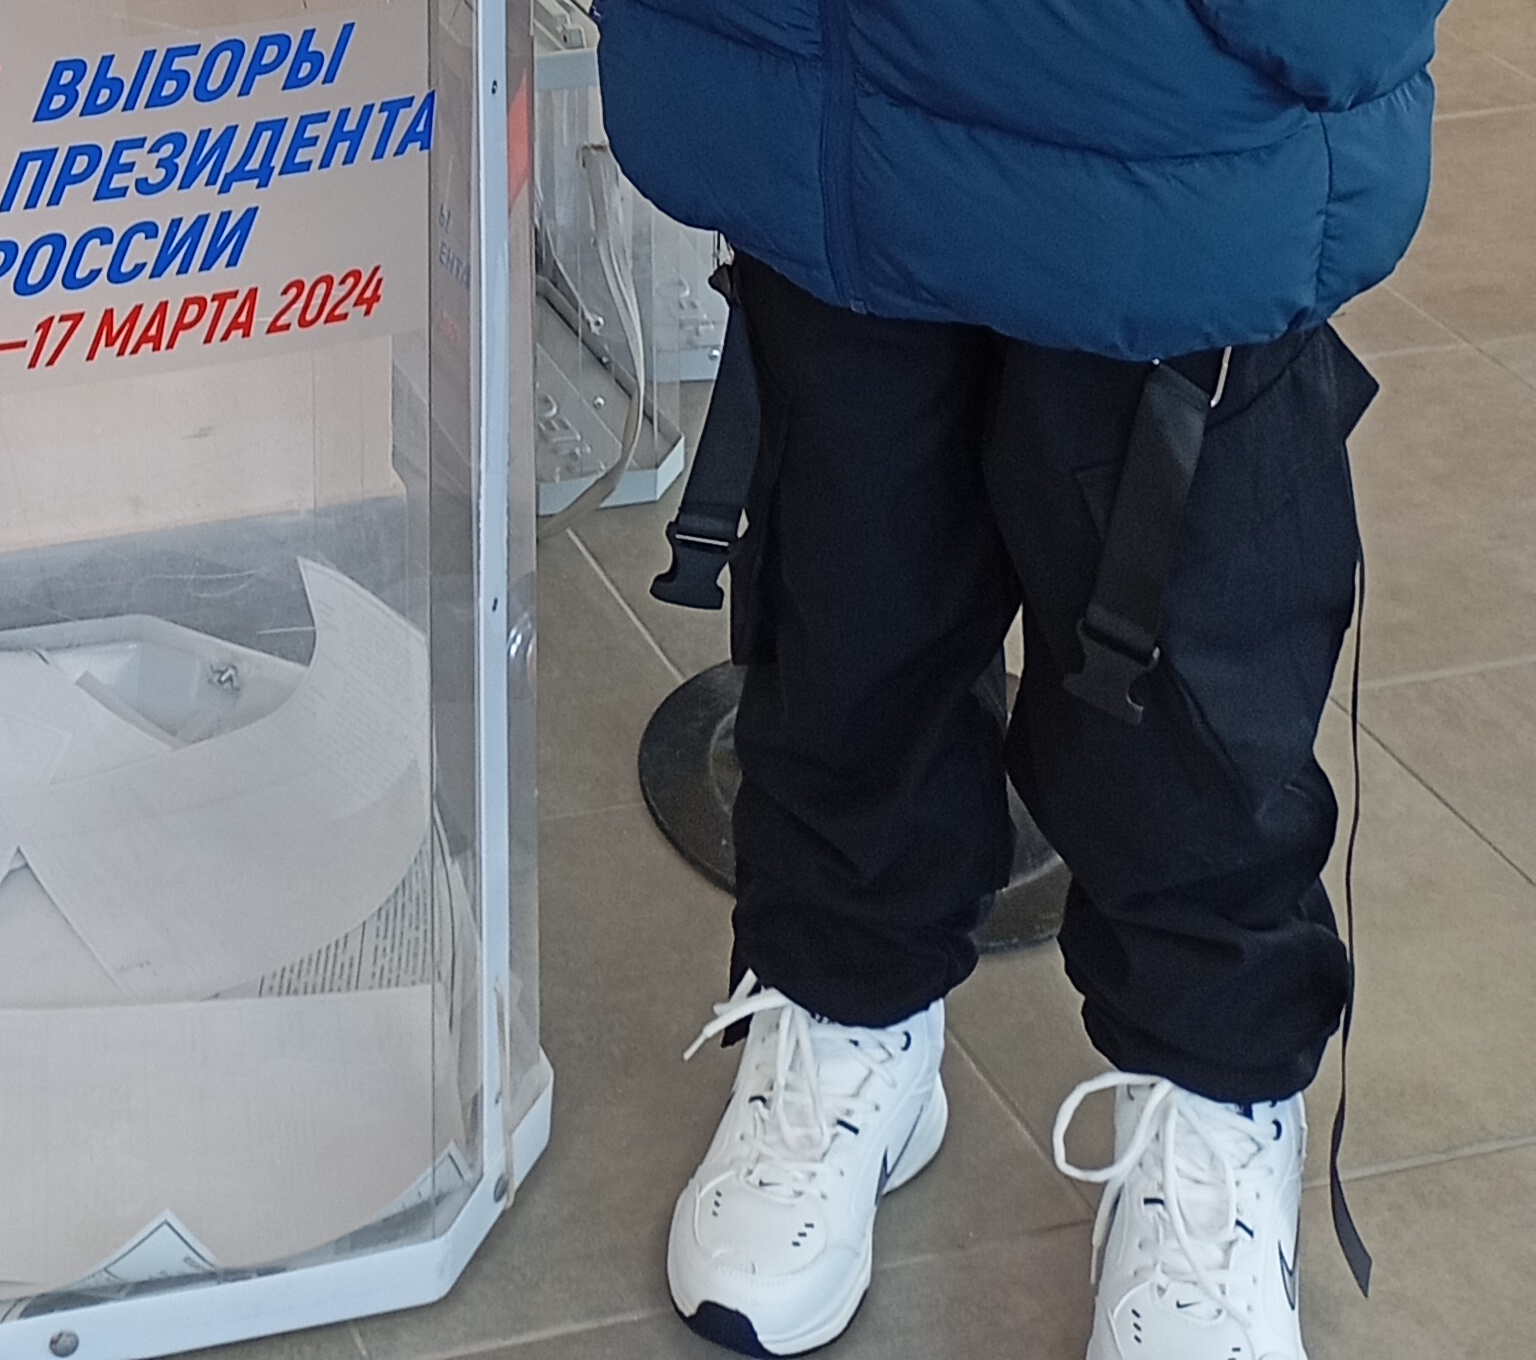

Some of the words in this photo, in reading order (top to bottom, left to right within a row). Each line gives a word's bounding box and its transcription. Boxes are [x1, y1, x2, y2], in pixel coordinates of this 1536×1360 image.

[33, 22, 356, 123] ВЫБОРЫ
[85, 287, 259, 362] МАРТА
[265, 265, 385, 335] 2024
